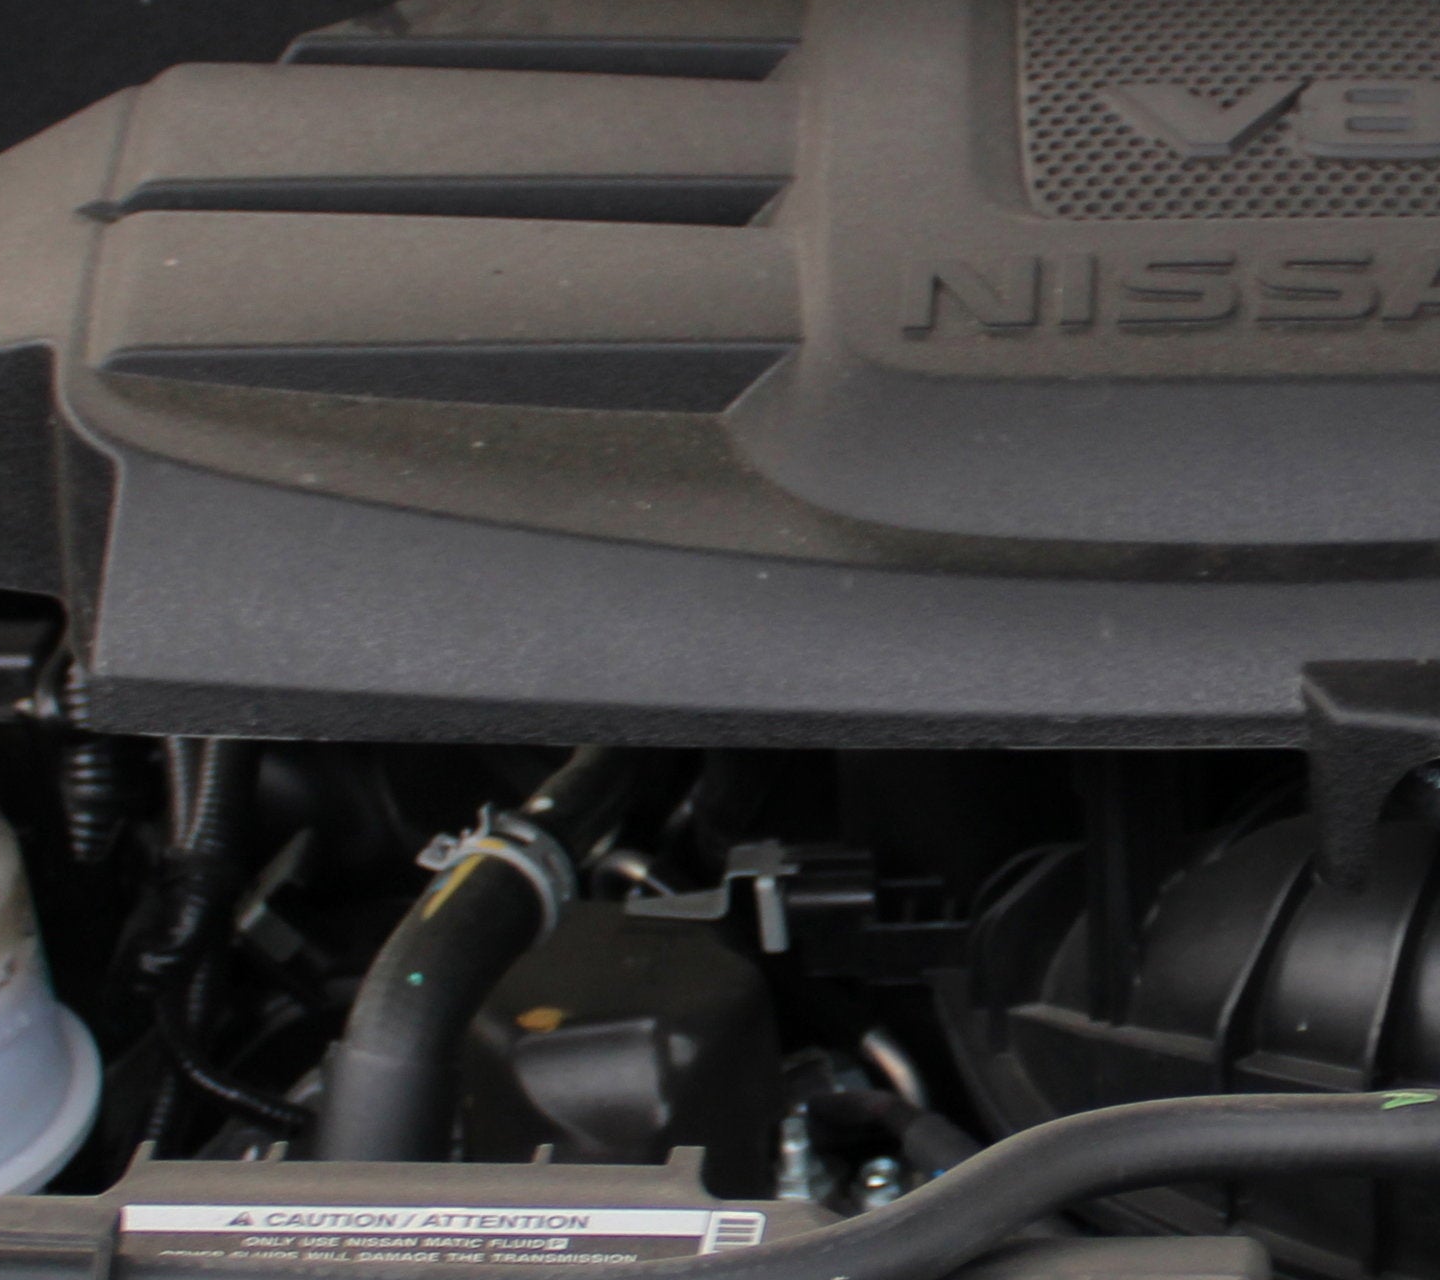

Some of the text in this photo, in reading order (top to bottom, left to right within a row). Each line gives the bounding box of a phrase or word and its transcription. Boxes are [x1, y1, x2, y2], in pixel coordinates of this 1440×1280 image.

[266, 1213, 398, 1228] CAUTION
[422, 1214, 590, 1230] ATTENTION
[244, 1237, 296, 1247] ONLY
[301, 1237, 340, 1247] USE
[344, 1237, 417, 1248] NISSAN
[425, 1238, 482, 1249] MATIC
[356, 1252, 440, 1262] DAMAGE
[446, 1252, 485, 1262] THE
[490, 1252, 639, 1264] TRANSMISSION
